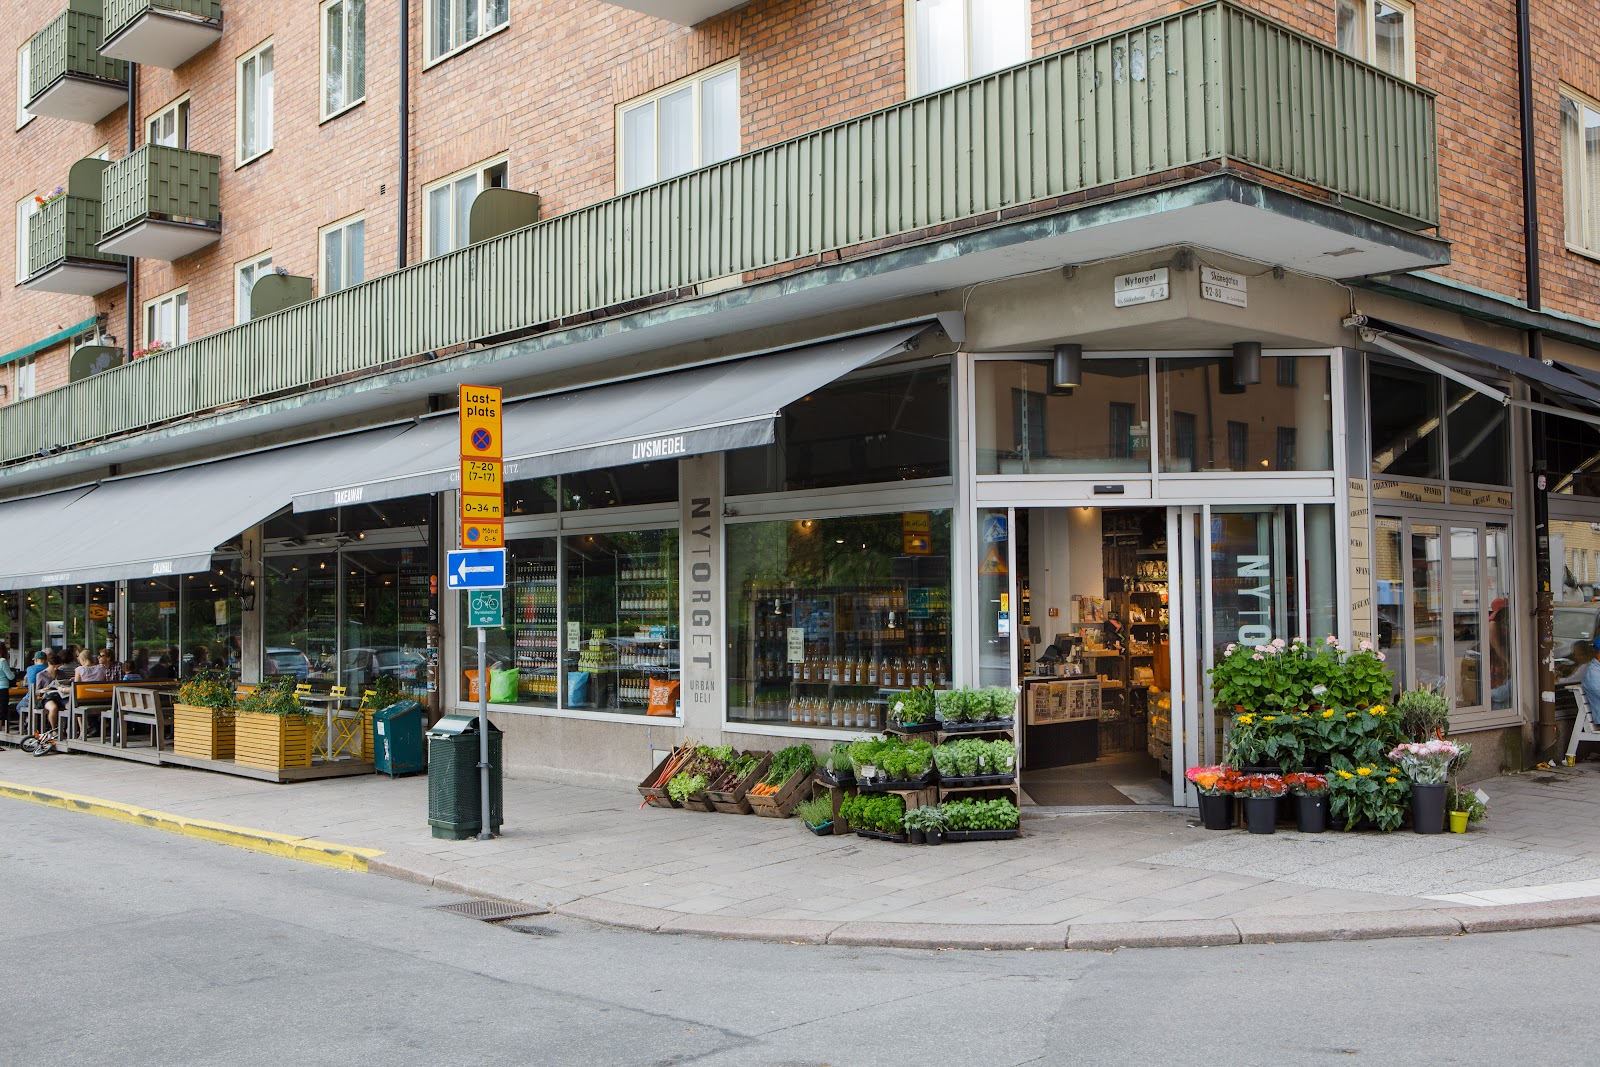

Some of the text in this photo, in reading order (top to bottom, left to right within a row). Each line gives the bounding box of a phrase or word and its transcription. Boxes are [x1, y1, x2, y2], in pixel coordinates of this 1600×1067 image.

[1125, 273, 1156, 287] Nytorget
[1151, 287, 1165, 298] 4-2
[466, 391, 496, 405] Last-
[467, 405, 496, 418] plats
[632, 436, 686, 460] LIVSMEDEL
[470, 461, 494, 472] 7-20
[469, 471, 496, 482] (7-17)
[334, 487, 364, 505] TAKEAWAY
[465, 503, 500, 513] 0-34 m
[691, 497, 712, 669] NYTORGET
[1237, 555, 1272, 646] NYTO
[690, 680, 715, 691] URBAN
[694, 692, 711, 704] DELI
